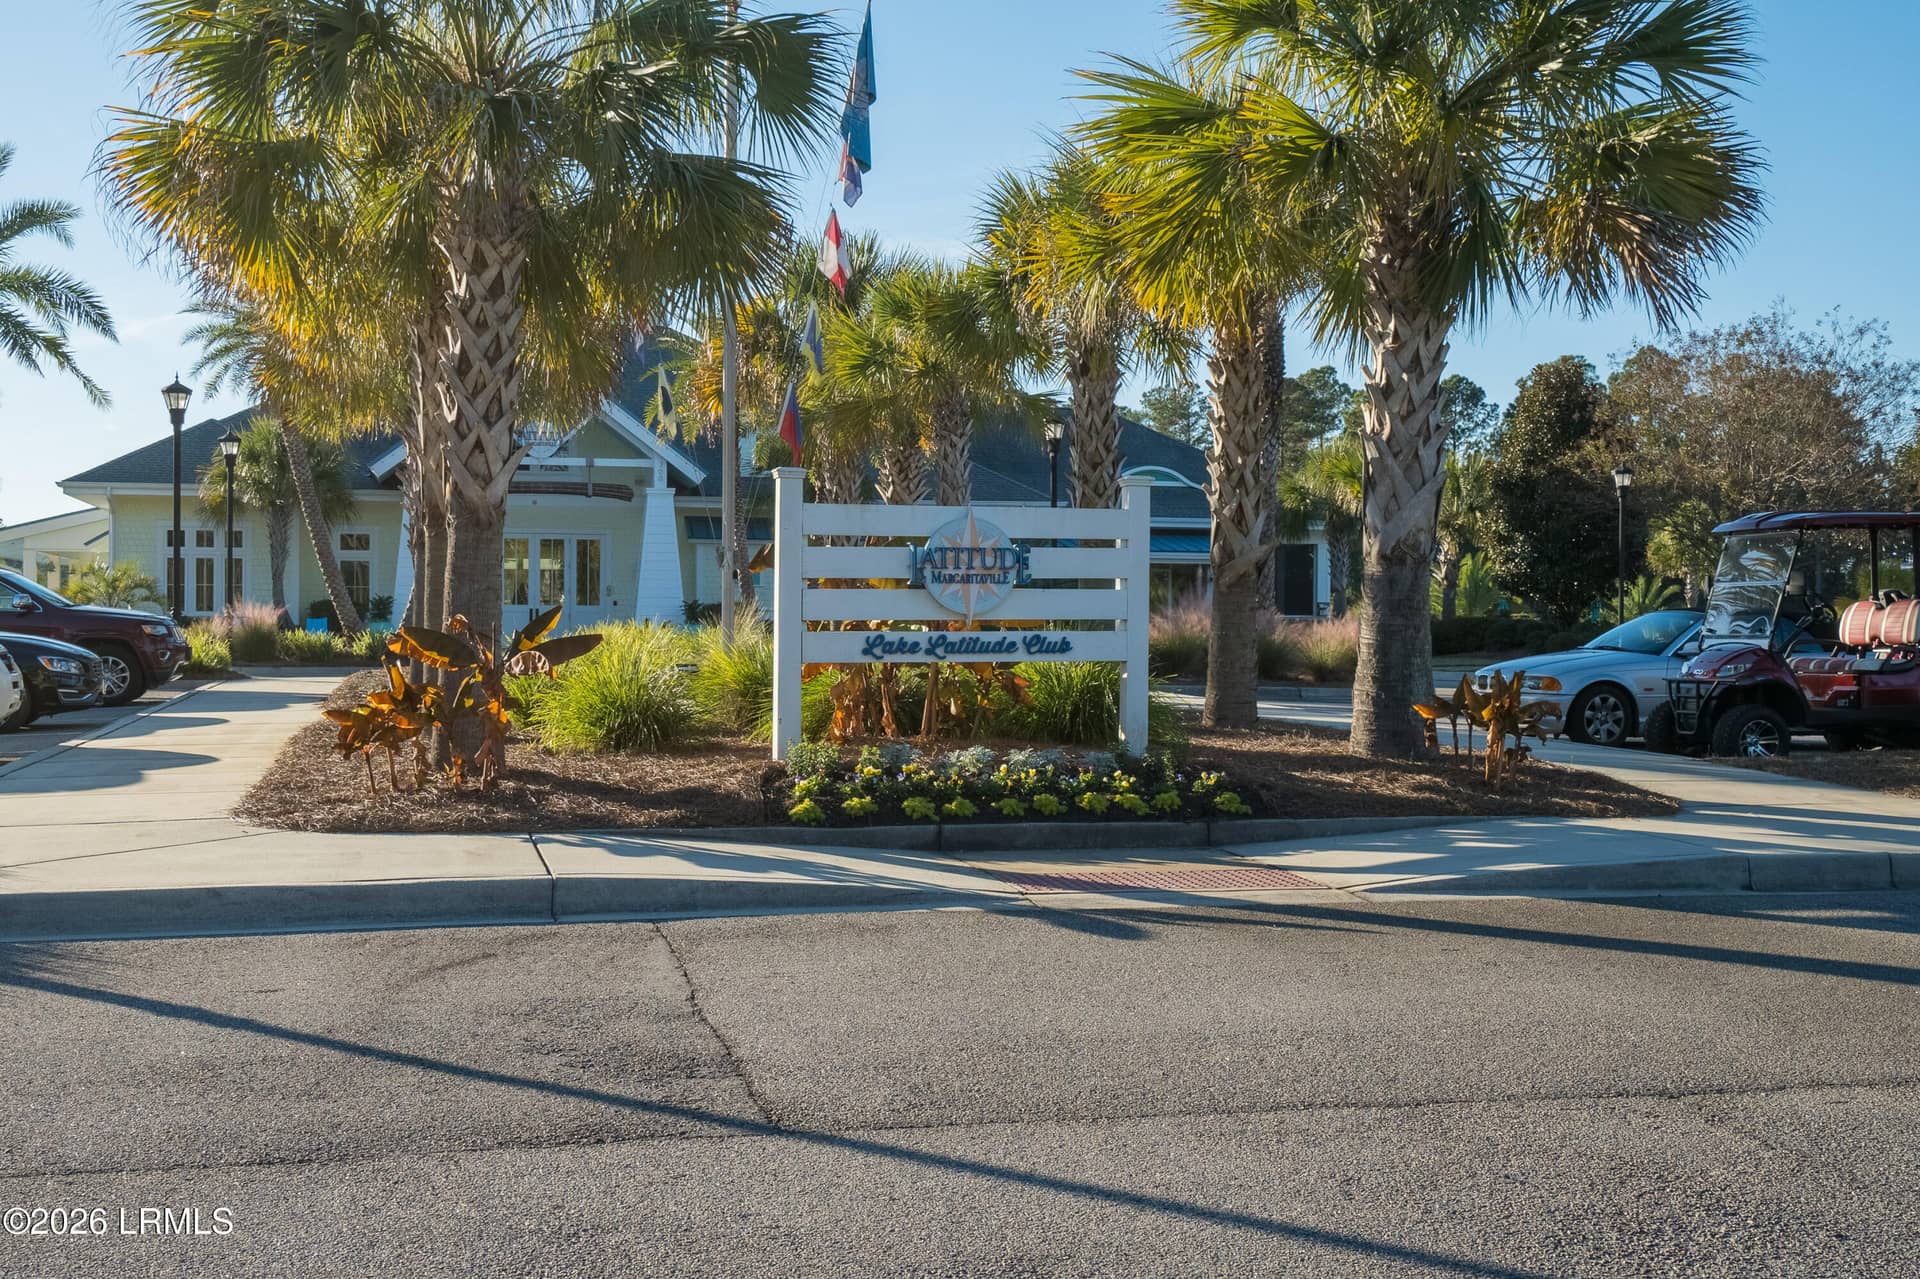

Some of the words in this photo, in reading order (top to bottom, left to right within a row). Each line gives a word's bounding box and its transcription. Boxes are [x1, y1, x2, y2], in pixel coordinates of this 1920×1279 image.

[907, 542, 1033, 584] LATITUDE
[931, 571, 1010, 585] MARGARITAVILLE
[862, 634, 922, 660] Lake
[924, 634, 1020, 660] Latitude
[1022, 634, 1073, 655] Club
